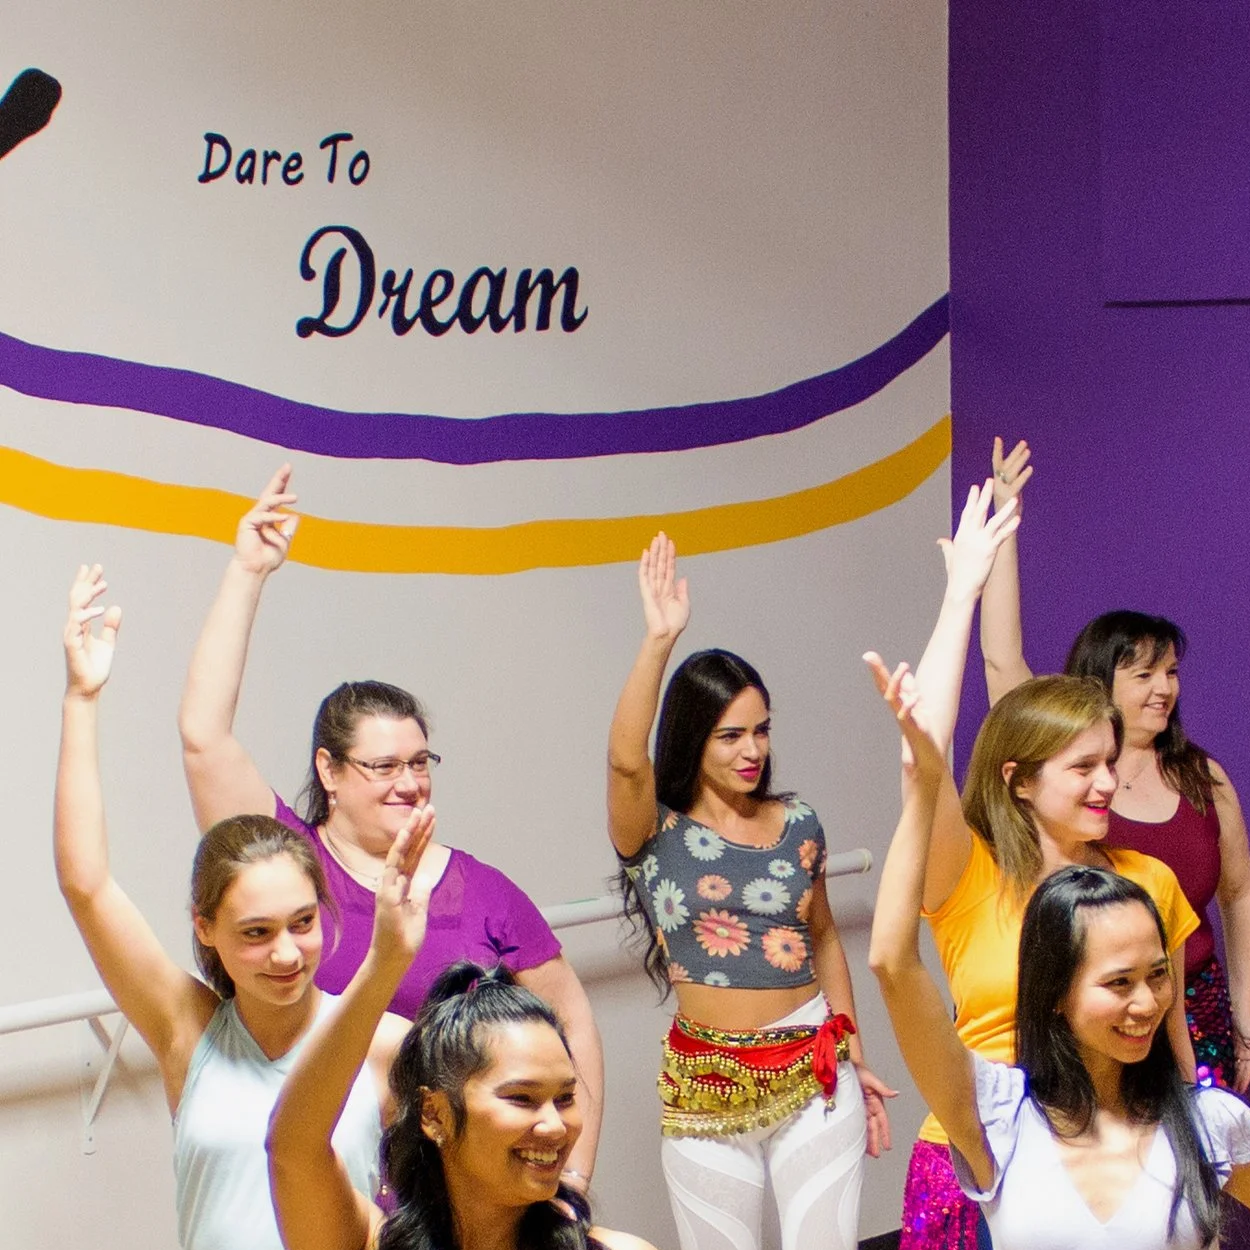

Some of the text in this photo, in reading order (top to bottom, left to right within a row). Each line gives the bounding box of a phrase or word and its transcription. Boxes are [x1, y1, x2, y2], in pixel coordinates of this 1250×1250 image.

[198, 132, 371, 186] Dare To
[296, 225, 589, 339] Dream
